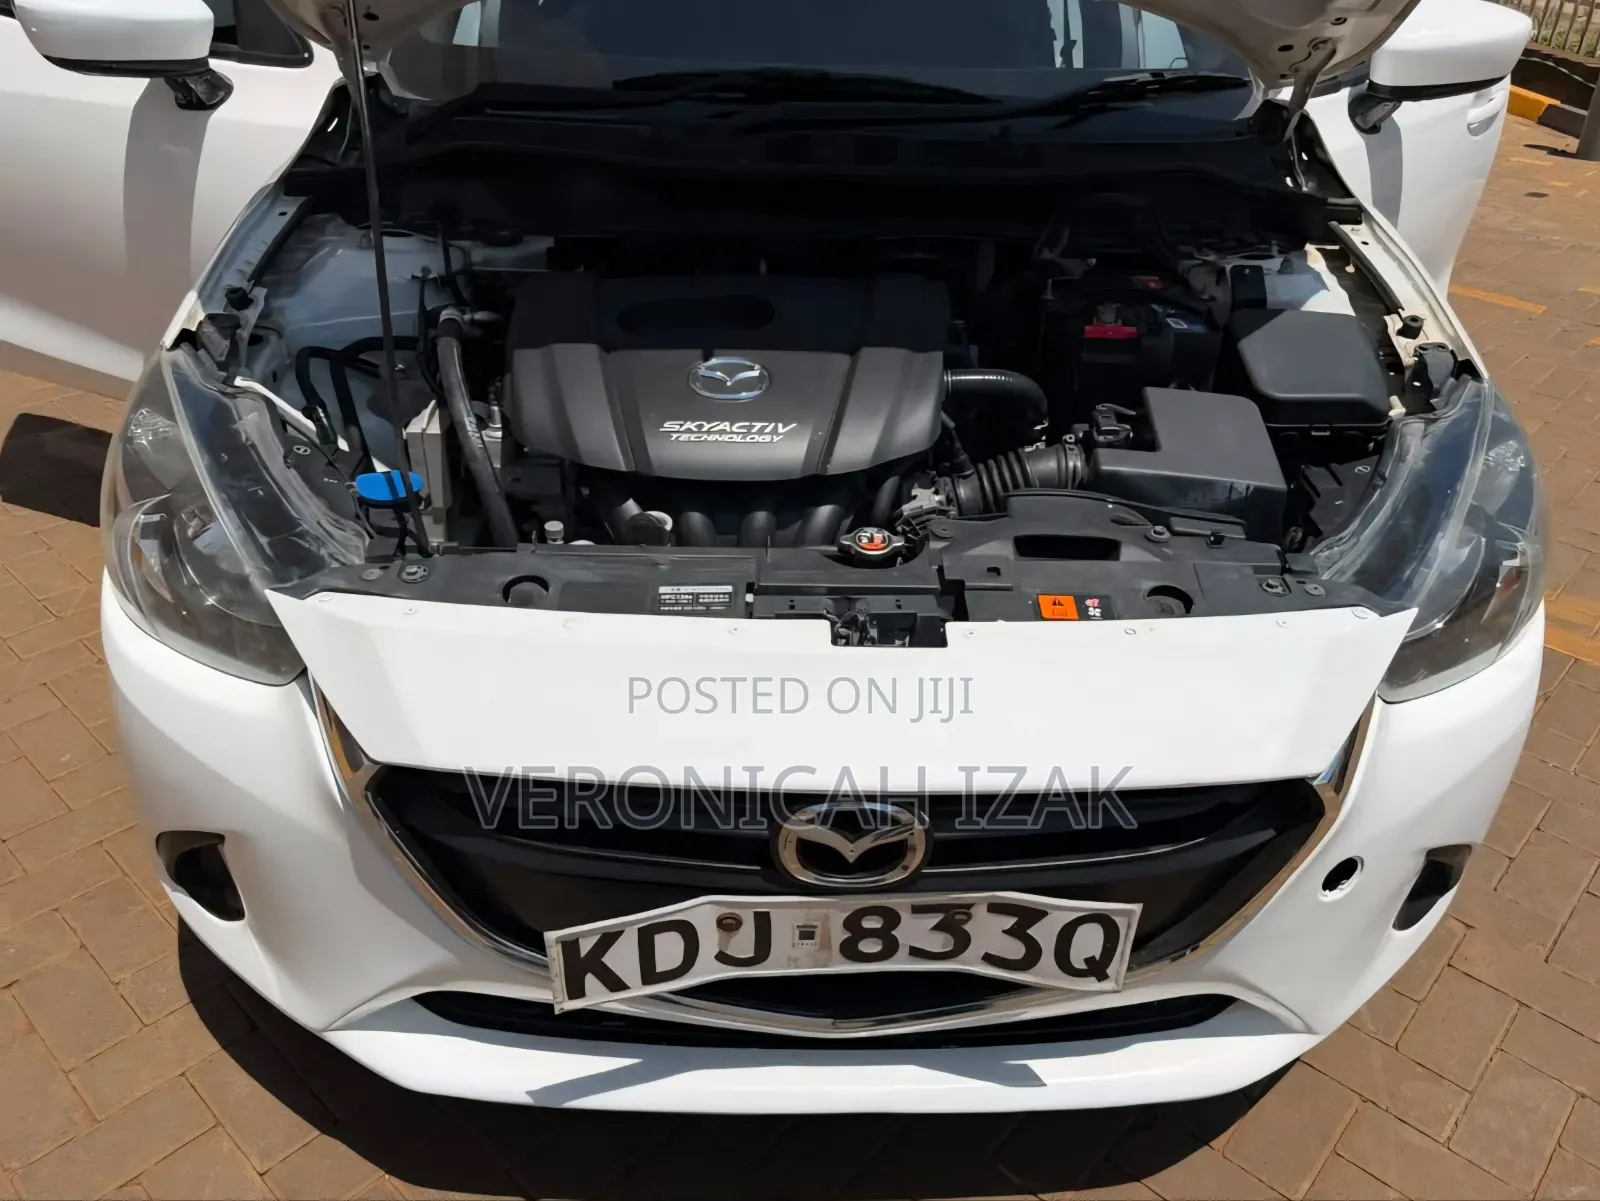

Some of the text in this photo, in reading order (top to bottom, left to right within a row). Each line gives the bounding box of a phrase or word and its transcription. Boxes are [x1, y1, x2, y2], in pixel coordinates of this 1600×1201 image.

[659, 420, 797, 433] SKYACTIV
[670, 433, 784, 443] TECHNOLOGY
[560, 902, 1120, 1001] KDJ 833Q
